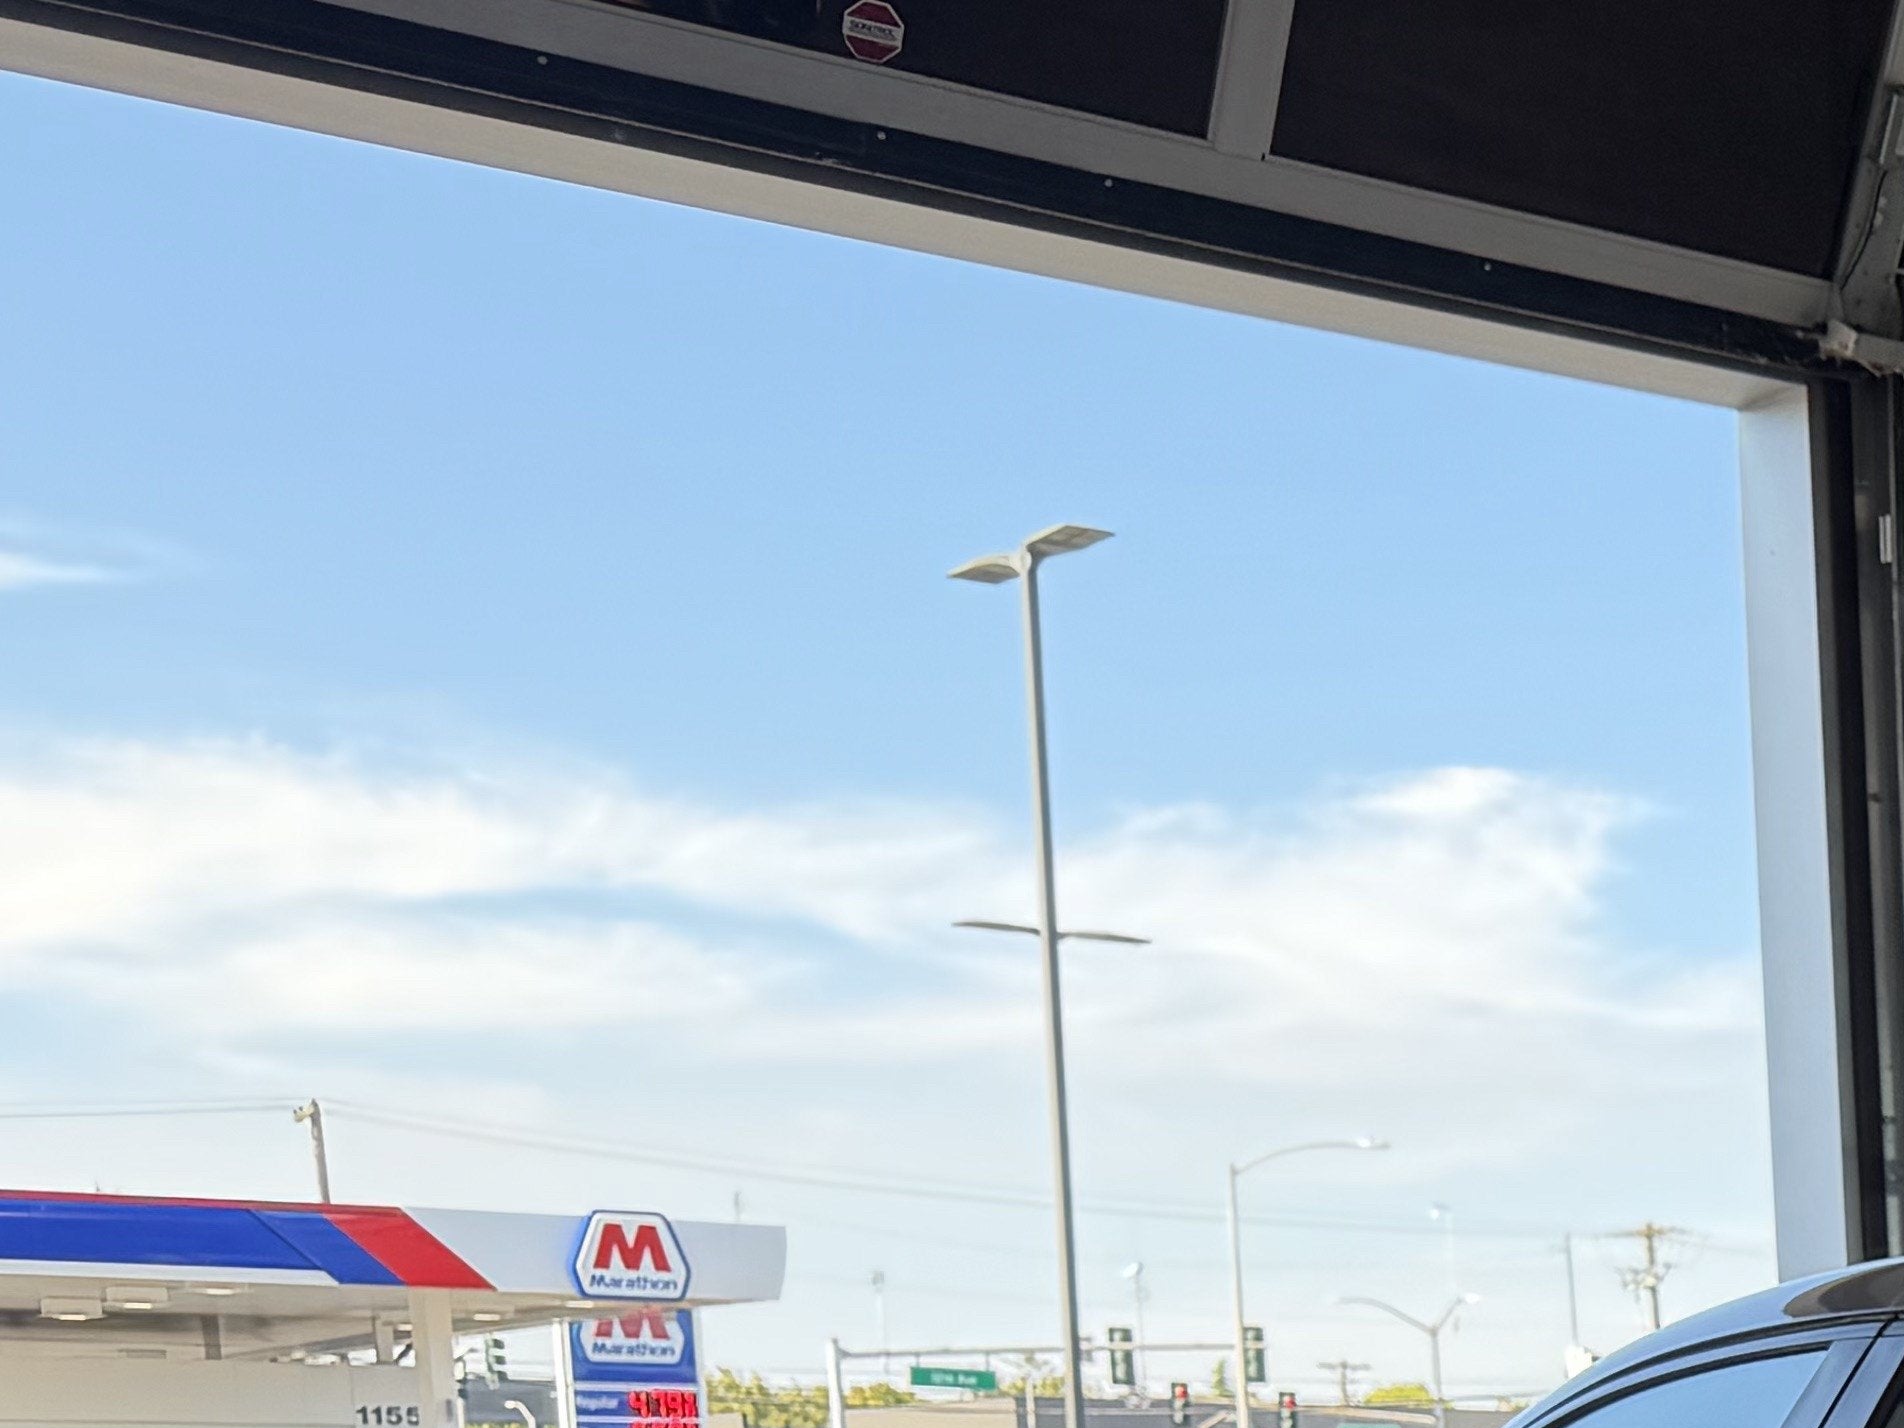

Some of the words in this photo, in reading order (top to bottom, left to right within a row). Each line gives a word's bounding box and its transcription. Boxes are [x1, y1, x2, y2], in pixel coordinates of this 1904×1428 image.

[593, 1223, 672, 1272] M
[590, 1274, 677, 1290] Marathon
[592, 1342, 675, 1356] Marathon
[356, 1406, 419, 1425] 1155
